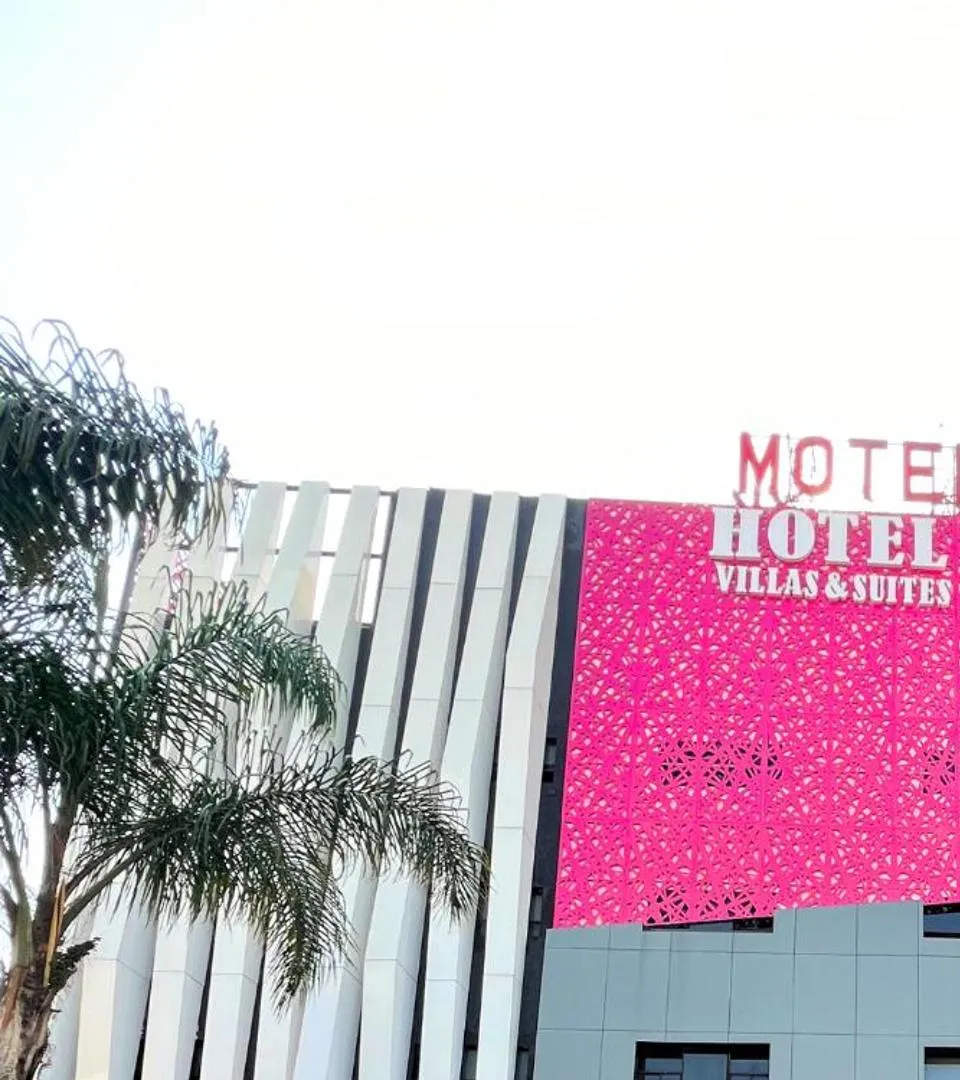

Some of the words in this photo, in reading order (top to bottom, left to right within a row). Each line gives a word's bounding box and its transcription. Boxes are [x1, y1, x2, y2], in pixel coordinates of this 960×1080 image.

[709, 505, 949, 570] HOTEL
[716, 565, 819, 600] VILLAS
[825, 571, 848, 602] &
[852, 575, 950, 607] SUITES
